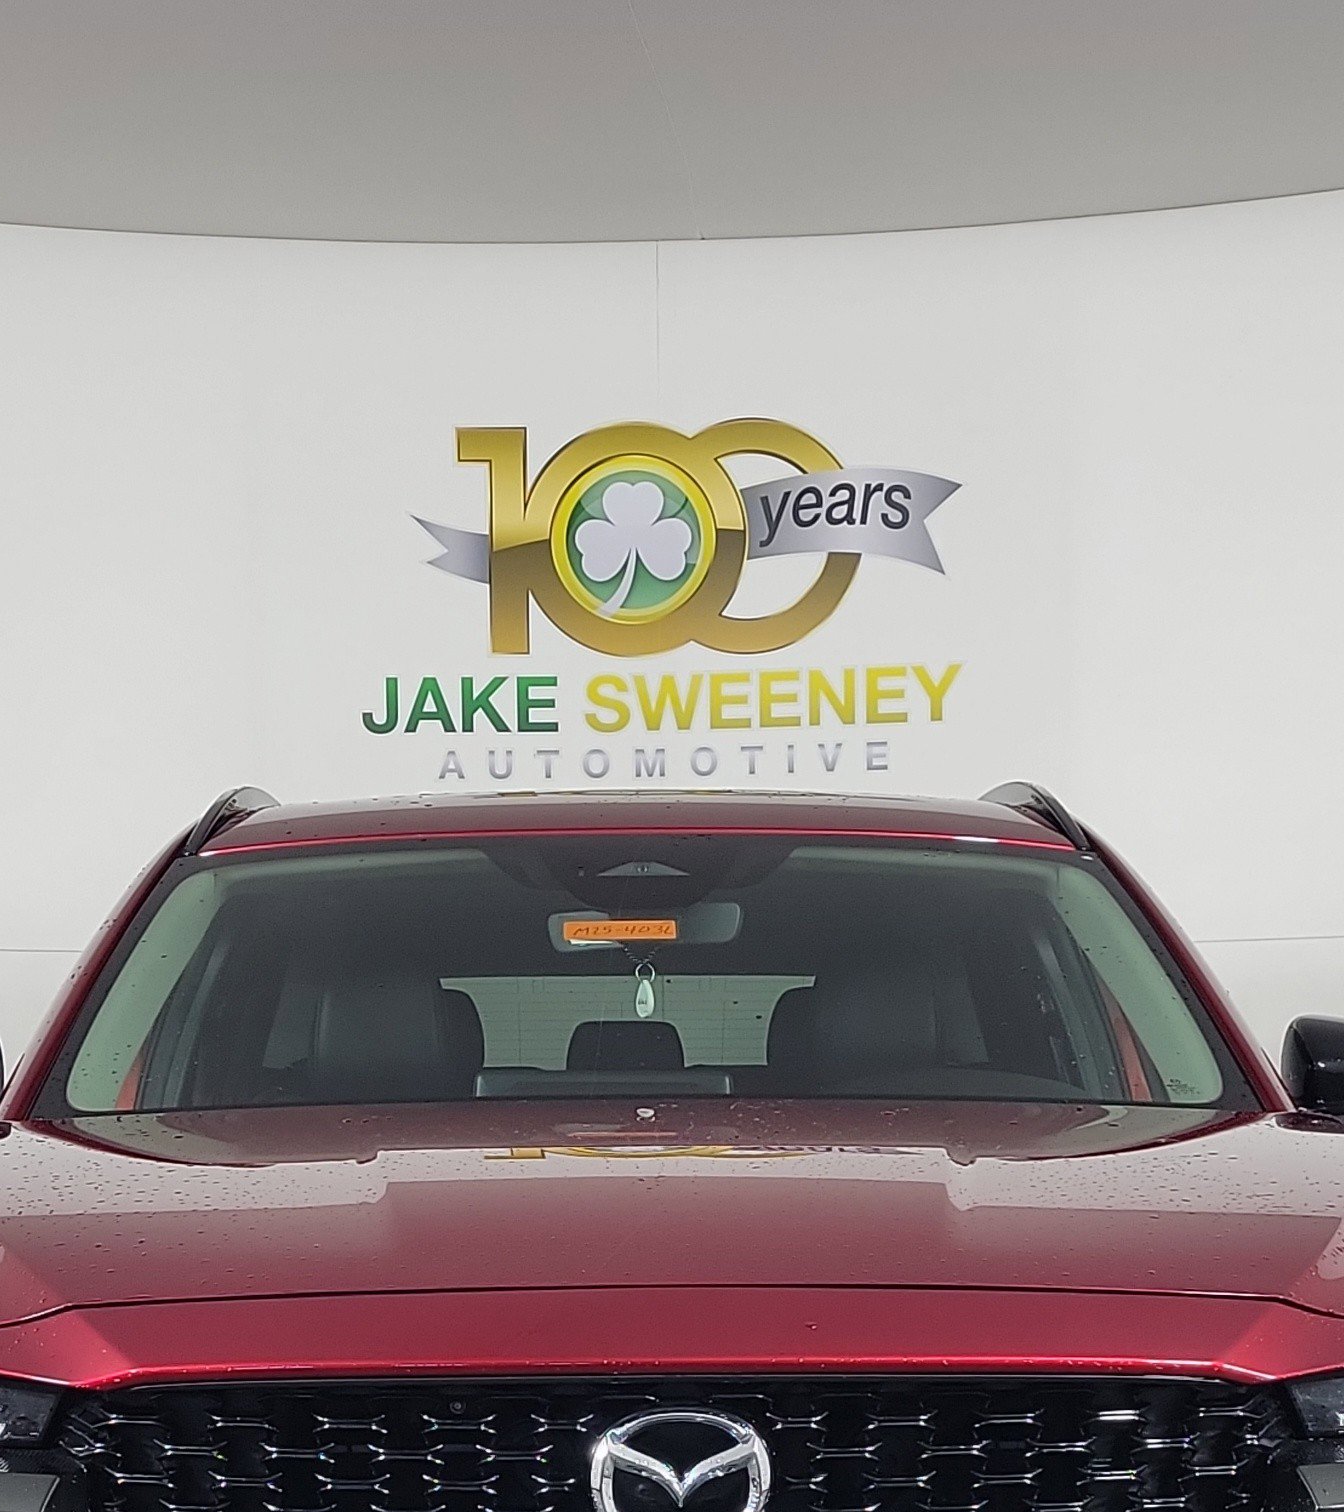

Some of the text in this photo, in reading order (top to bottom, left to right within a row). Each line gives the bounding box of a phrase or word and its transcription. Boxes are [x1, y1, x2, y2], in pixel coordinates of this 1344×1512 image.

[456, 417, 912, 657] 100 years
[361, 663, 962, 735] JAKE SWEENEY
[439, 741, 889, 780] AUTOMOTIVE
